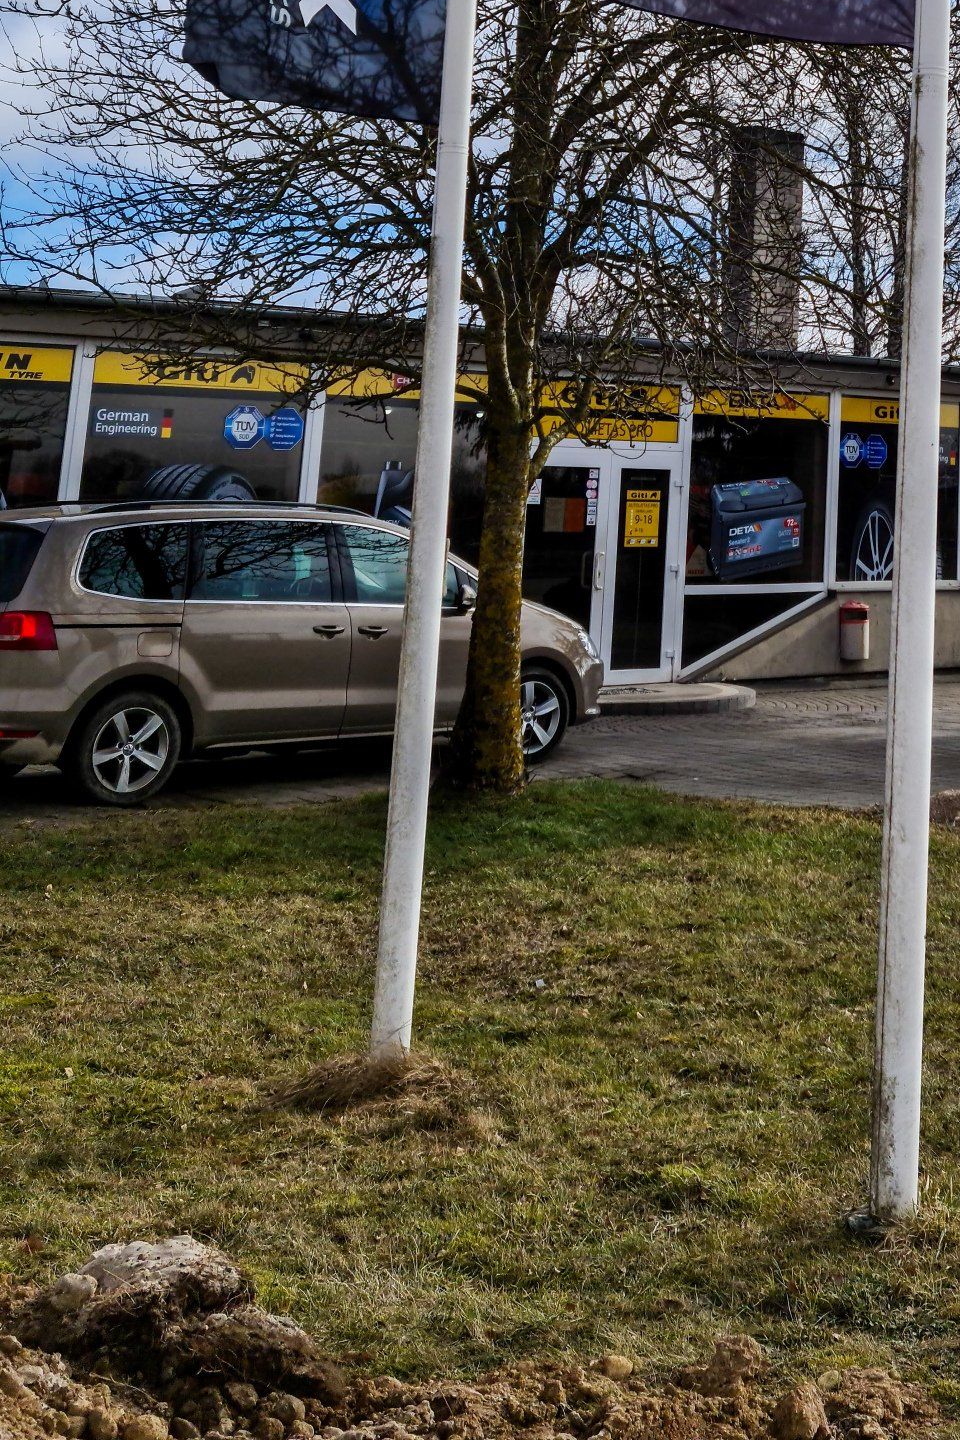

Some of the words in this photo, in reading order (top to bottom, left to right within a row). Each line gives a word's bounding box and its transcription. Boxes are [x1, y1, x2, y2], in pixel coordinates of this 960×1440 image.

[9, 371, 43, 379] TYRE
[96, 408, 149, 422] German
[95, 422, 158, 436] Engineering
[235, 420, 256, 431] TÜV
[634, 514, 653, 525] 9-18
[729, 525, 755, 537] DETA
